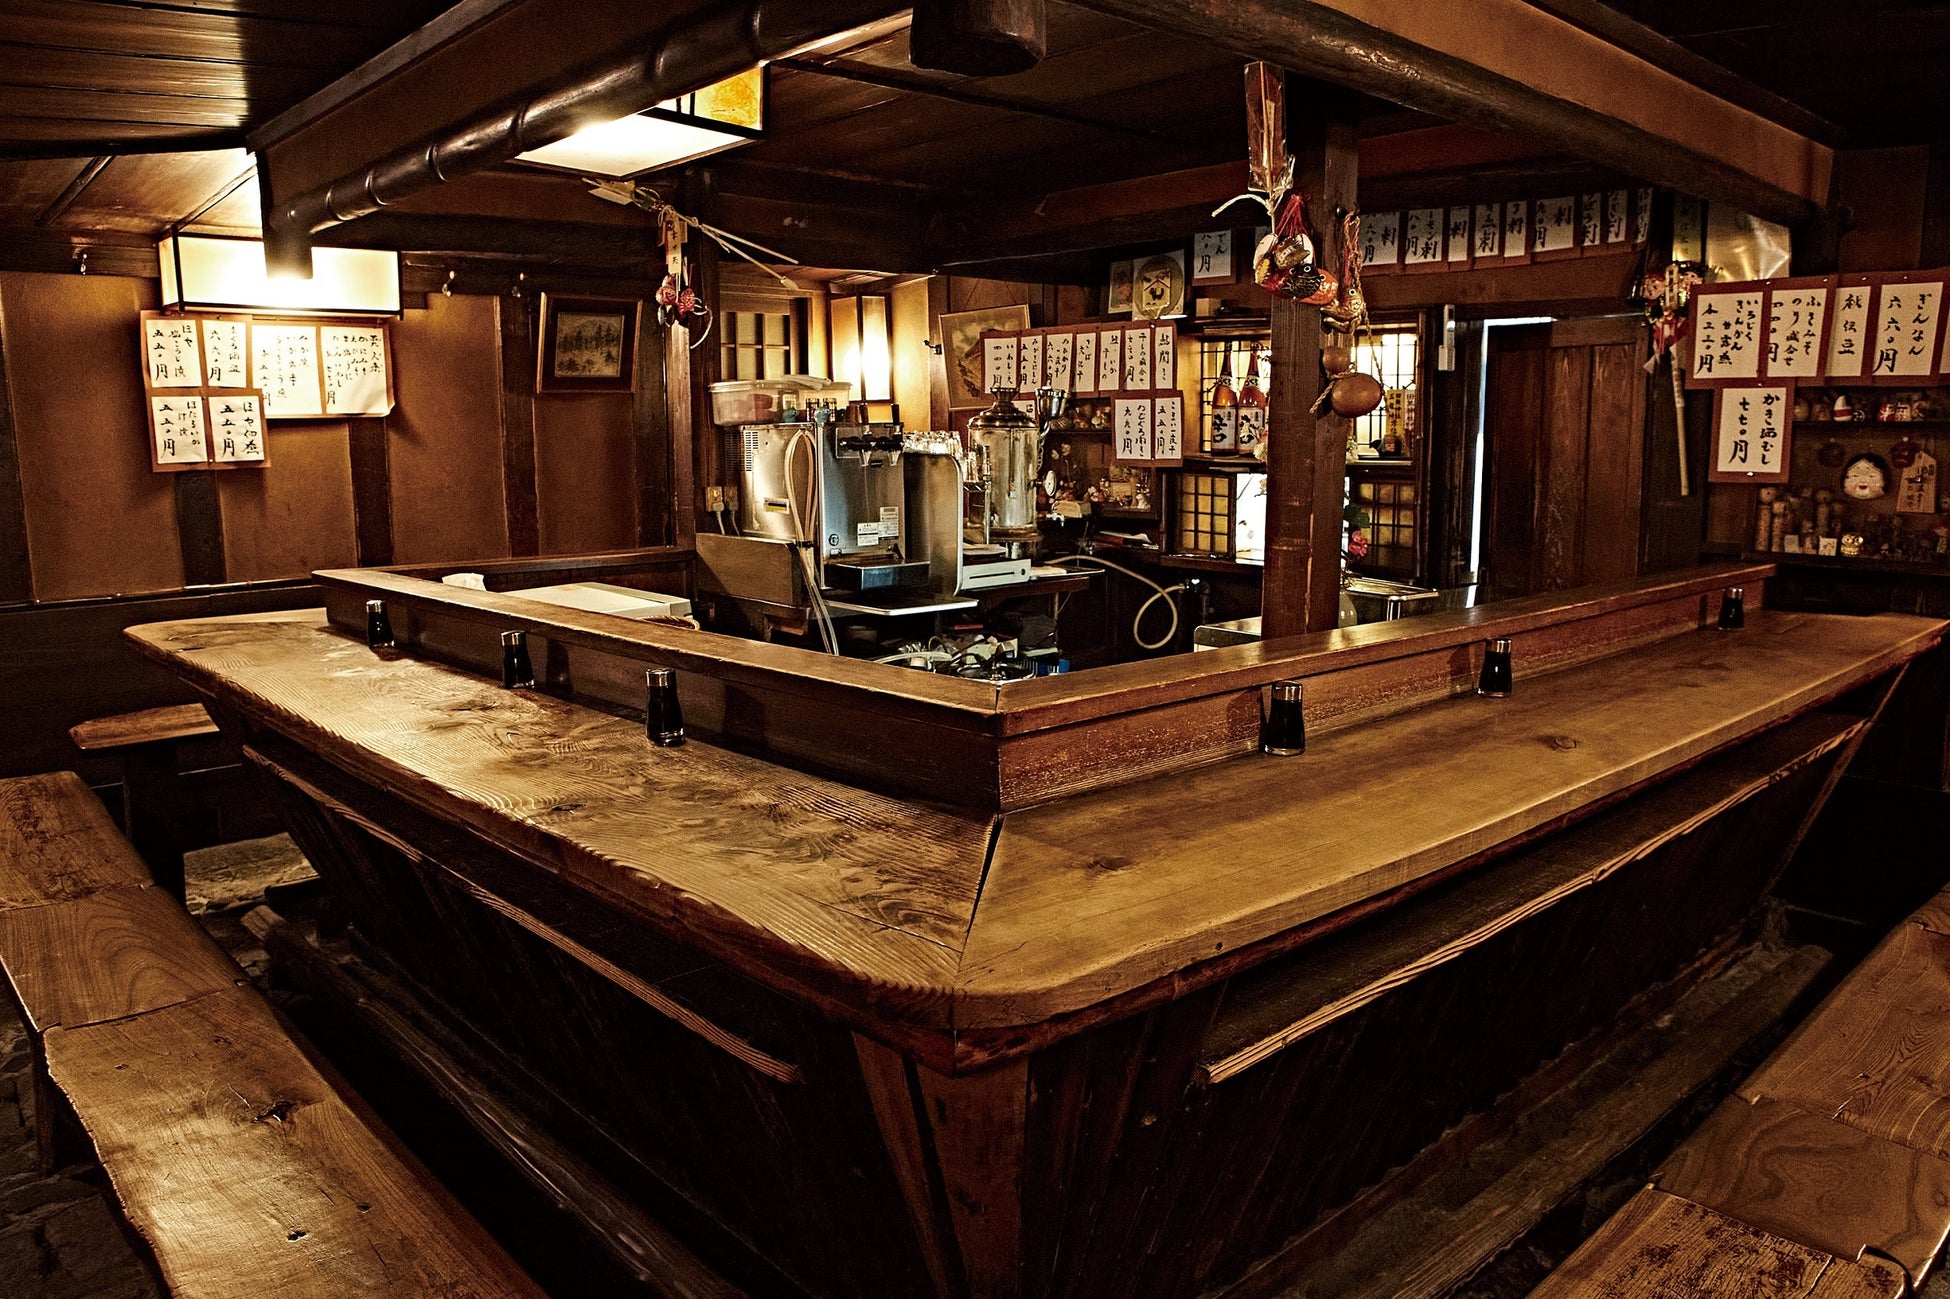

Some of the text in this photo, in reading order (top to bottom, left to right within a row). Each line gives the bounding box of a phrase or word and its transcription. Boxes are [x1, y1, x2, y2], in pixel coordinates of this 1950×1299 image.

[1363, 214, 1376, 264] 六〇円
[1731, 299, 1744, 351] きんかん
[1745, 299, 1759, 342] いちじく
[1908, 293, 1932, 356] ぎんなん
[1213, 413, 1228, 443] 辛口
